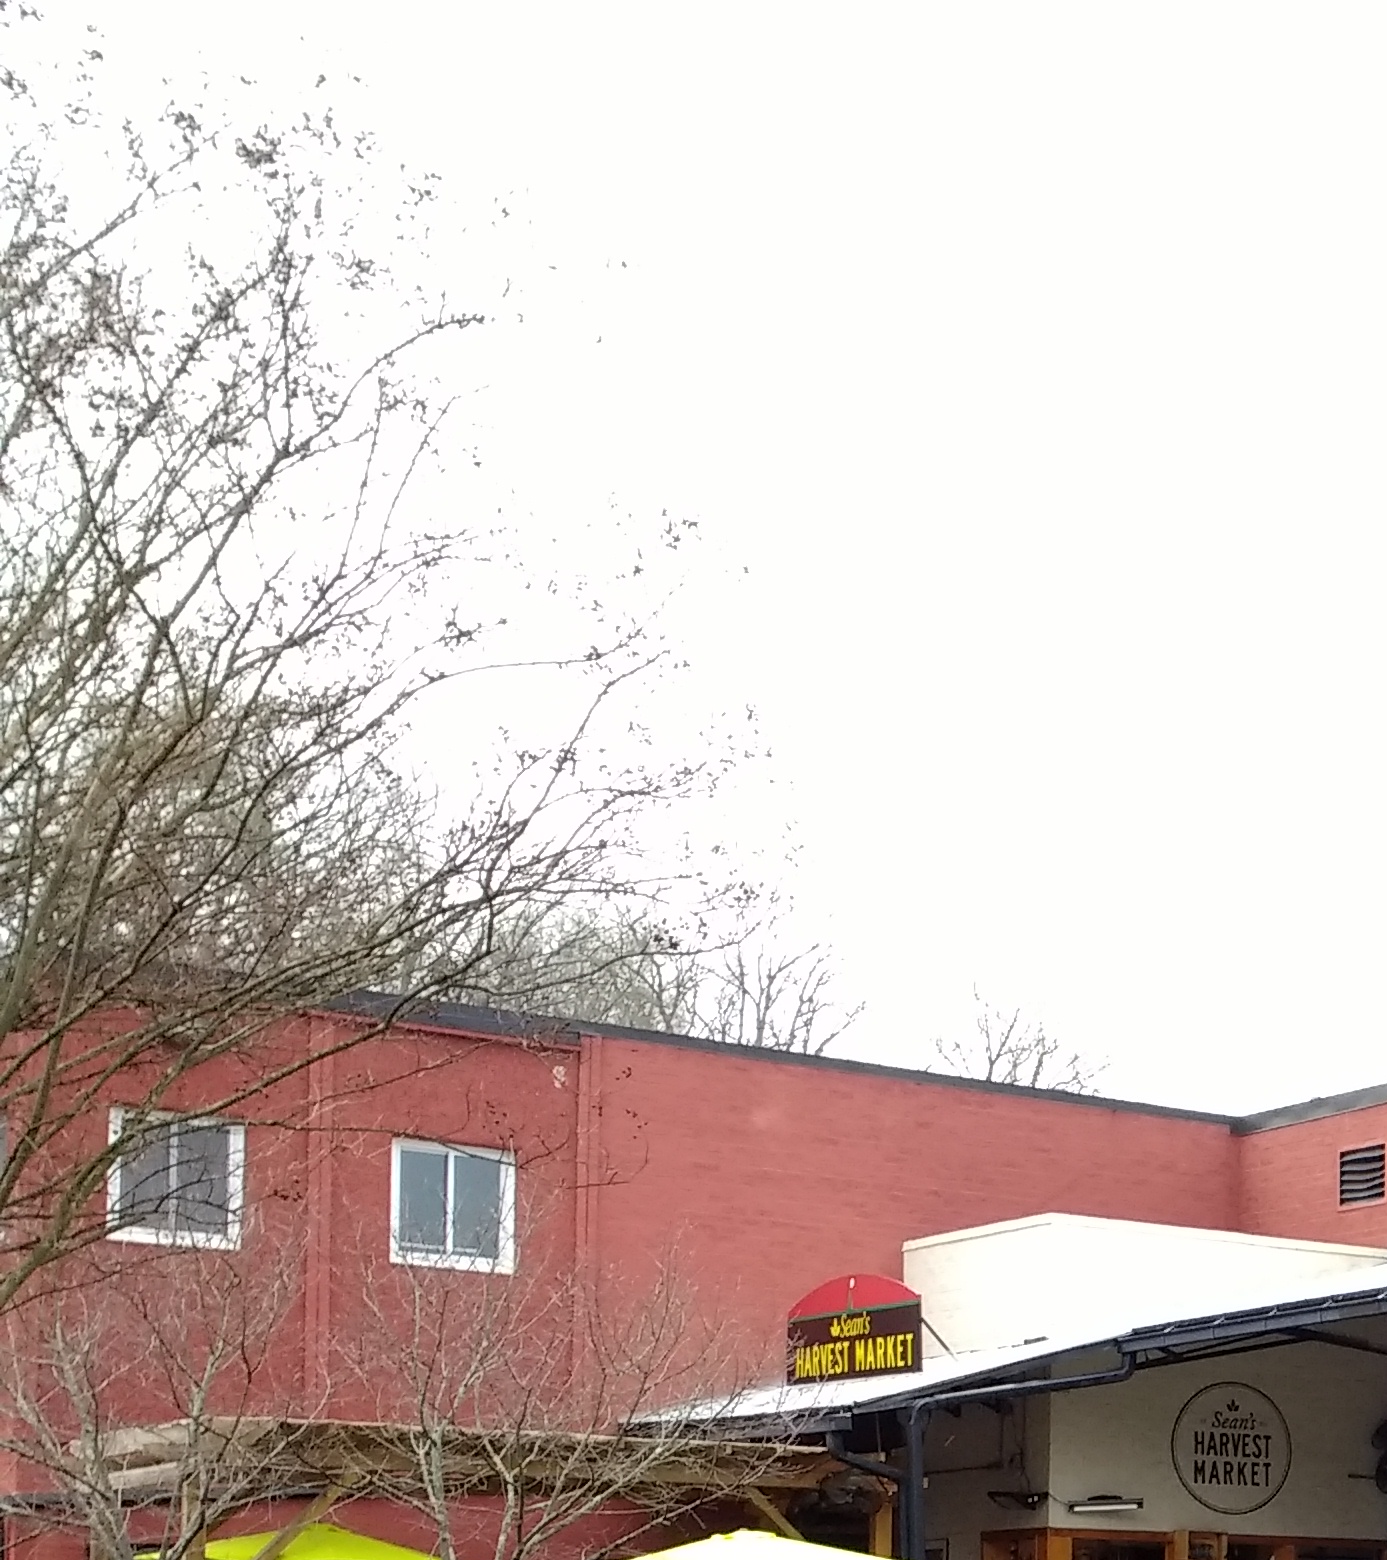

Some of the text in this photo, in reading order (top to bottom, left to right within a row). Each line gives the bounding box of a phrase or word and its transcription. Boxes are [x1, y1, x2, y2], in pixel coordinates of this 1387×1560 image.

[840, 1311, 871, 1338] Sean's
[796, 1333, 914, 1379] HARVEST MARKET
[1211, 1411, 1257, 1430] Sean's
[1194, 1431, 1272, 1459] HARVEST
[1193, 1460, 1272, 1487] MARKET
